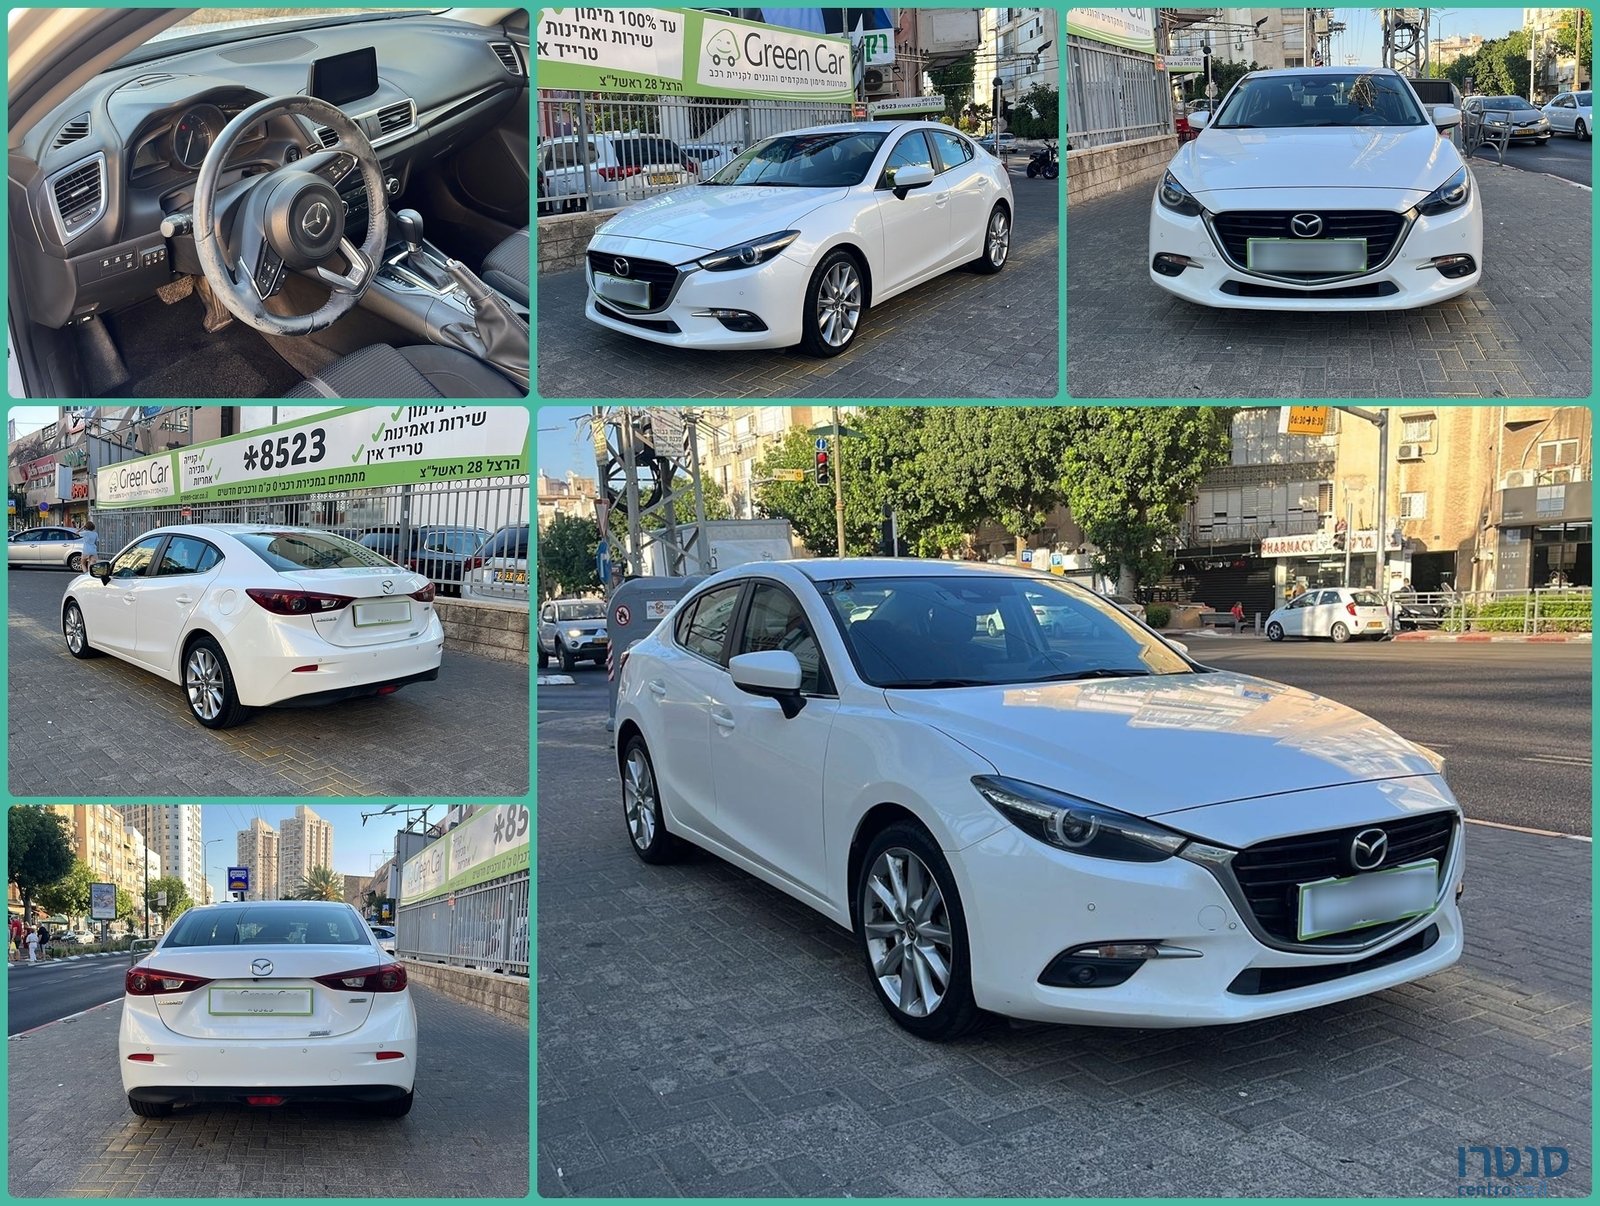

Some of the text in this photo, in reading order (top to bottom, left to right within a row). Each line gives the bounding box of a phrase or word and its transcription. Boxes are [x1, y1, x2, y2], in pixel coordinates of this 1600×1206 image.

[575, 8, 676, 33] עד 100% מימון
[545, 20, 653, 47] שירות ואמינות
[554, 43, 599, 61] טרייד
[744, 32, 845, 75] Green Car
[709, 69, 724, 78] רכב
[727, 71, 751, 81] לקניית
[754, 73, 778, 82] והוגנים
[644, 78, 657, 90] 28
[659, 79, 683, 92] הרצל
[780, 75, 808, 85] מתקדמים
[810, 78, 825, 87] מימון
[384, 411, 487, 442] שירות ואמינות
[366, 442, 423, 465] טרייד אין
[183, 454, 198, 465] קנייה
[188, 465, 205, 476] מכירה
[467, 461, 483, 474] 28
[486, 459, 520, 472] הרצל
[119, 461, 169, 490] Green Car
[193, 475, 213, 486] אחריות
[328, 471, 366, 485] מתמחים
[272, 481, 278, 491] 0
[279, 481, 295, 491] רכבי
[296, 477, 325, 488] במכירת
[217, 487, 236, 496] חדשים
[237, 485, 257, 495] ורכבים
[1261, 539, 1315, 555] PHARMACY
